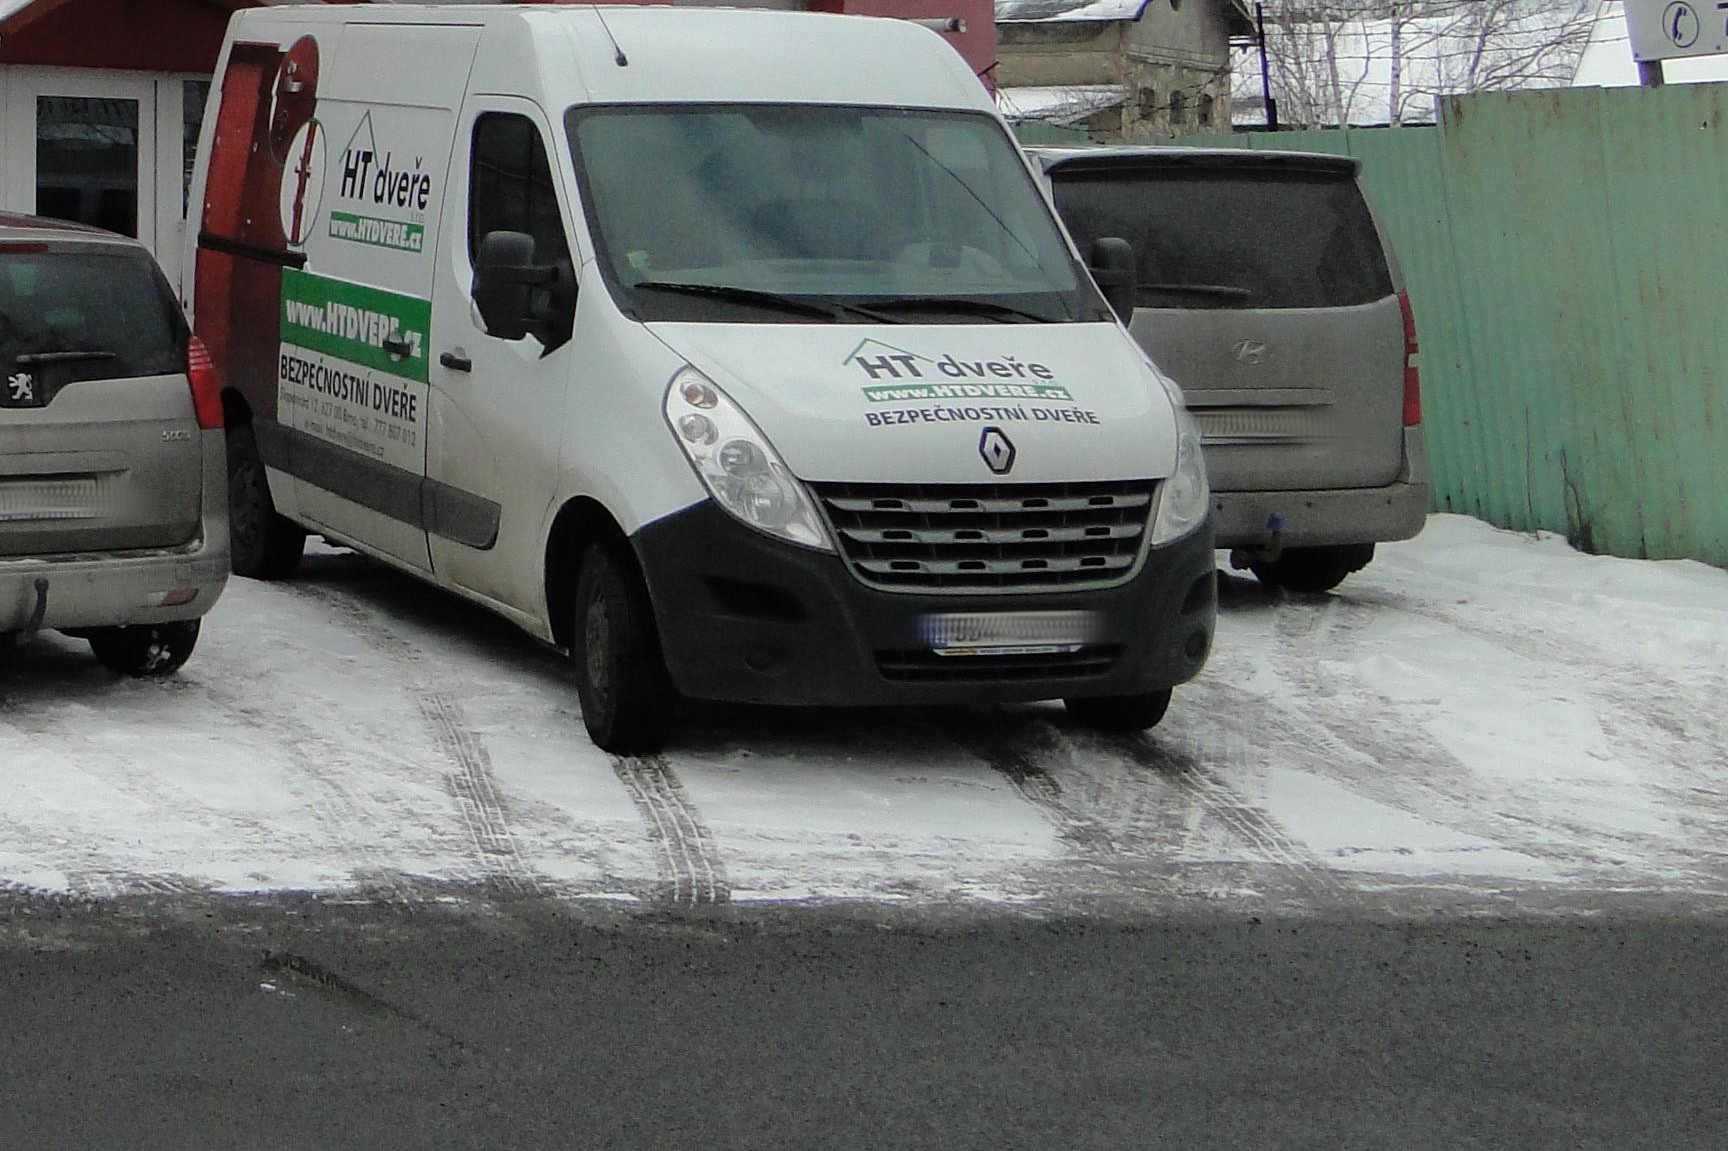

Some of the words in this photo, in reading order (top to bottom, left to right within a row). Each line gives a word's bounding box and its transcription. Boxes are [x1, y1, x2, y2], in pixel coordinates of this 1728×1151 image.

[341, 149, 373, 200] HT
[374, 151, 430, 210] dveře
[330, 217, 422, 250] www.HTDVERE.cz
[286, 300, 422, 358] www.HTDVERcz
[856, 354, 924, 379] HT
[937, 353, 1054, 379] dveře
[280, 355, 371, 407] BEZPEČNOSTNÍ
[373, 383, 417, 422] DVEŘE
[867, 384, 1069, 400] www.HTDVERE.cz
[865, 404, 1028, 427] BEZPEČNOSTNÍ
[1032, 406, 1101, 425] DVEŘE
